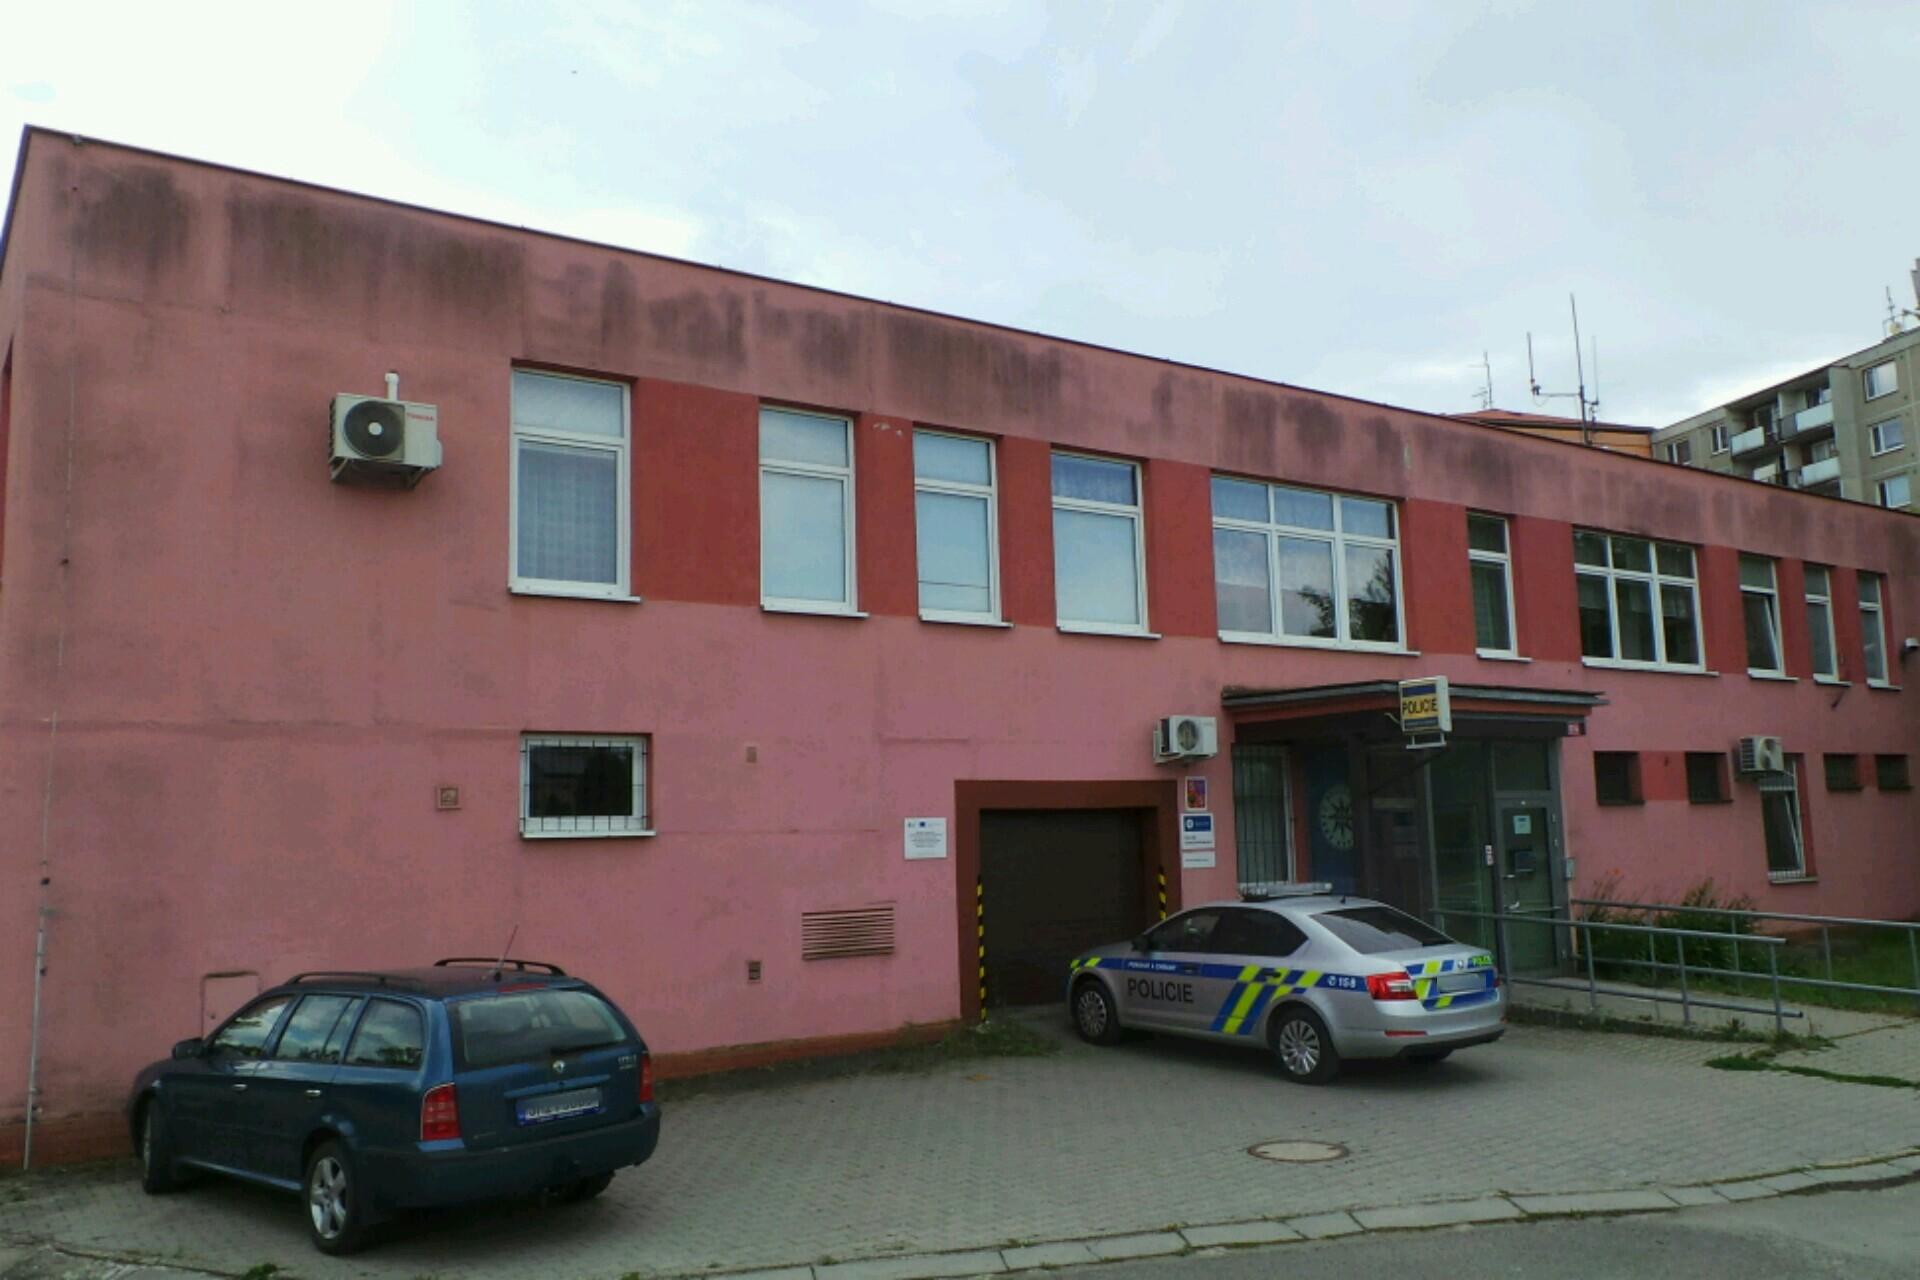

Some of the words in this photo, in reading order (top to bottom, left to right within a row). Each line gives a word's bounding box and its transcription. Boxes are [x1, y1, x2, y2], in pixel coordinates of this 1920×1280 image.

[1402, 698, 1437, 715] POLICIE
[1127, 977, 1194, 1004] POLICIE
[1338, 976, 1356, 988] 158
